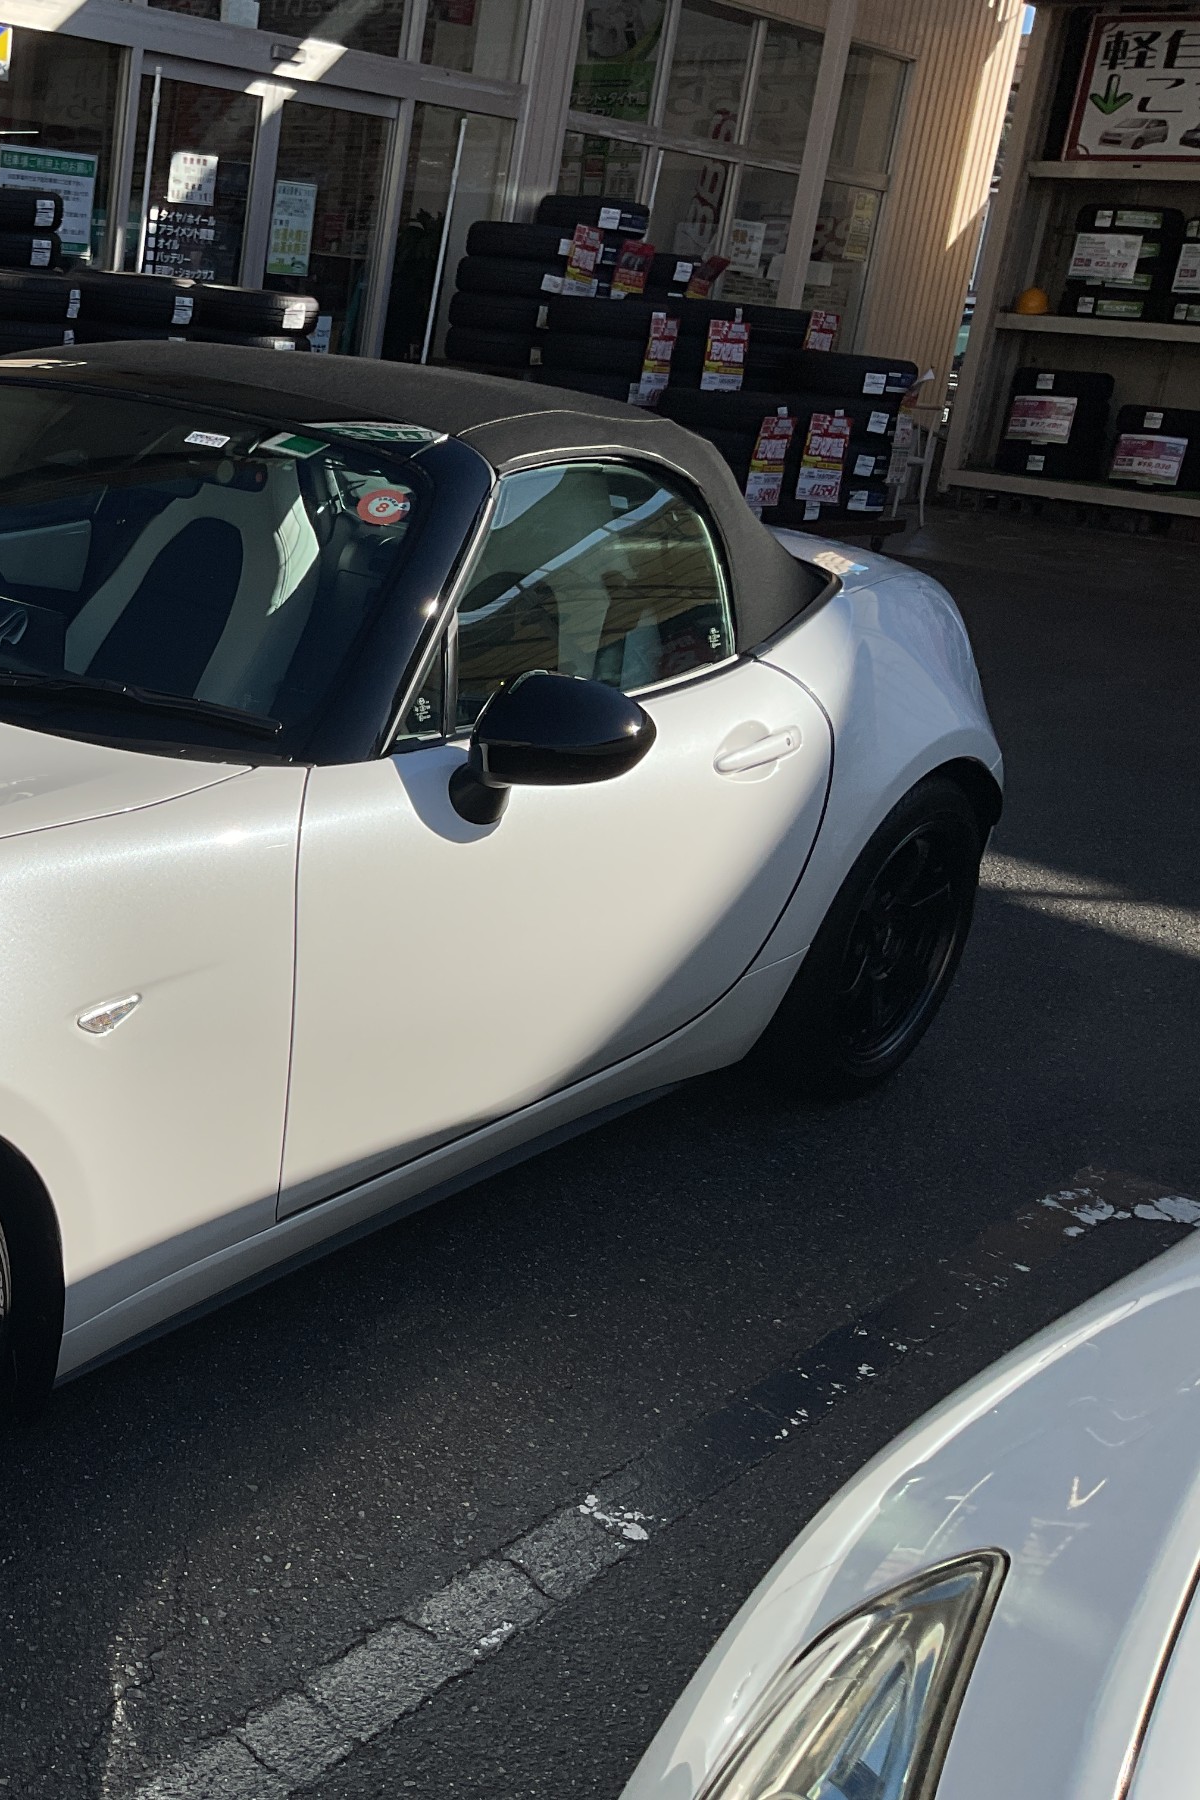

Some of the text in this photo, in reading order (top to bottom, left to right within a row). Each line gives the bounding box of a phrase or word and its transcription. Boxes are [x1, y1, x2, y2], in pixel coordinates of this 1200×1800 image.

[160, 209, 216, 226] タイヤ/ホイール
[157, 239, 180, 250] オイル
[155, 251, 192, 265] バッテリー
